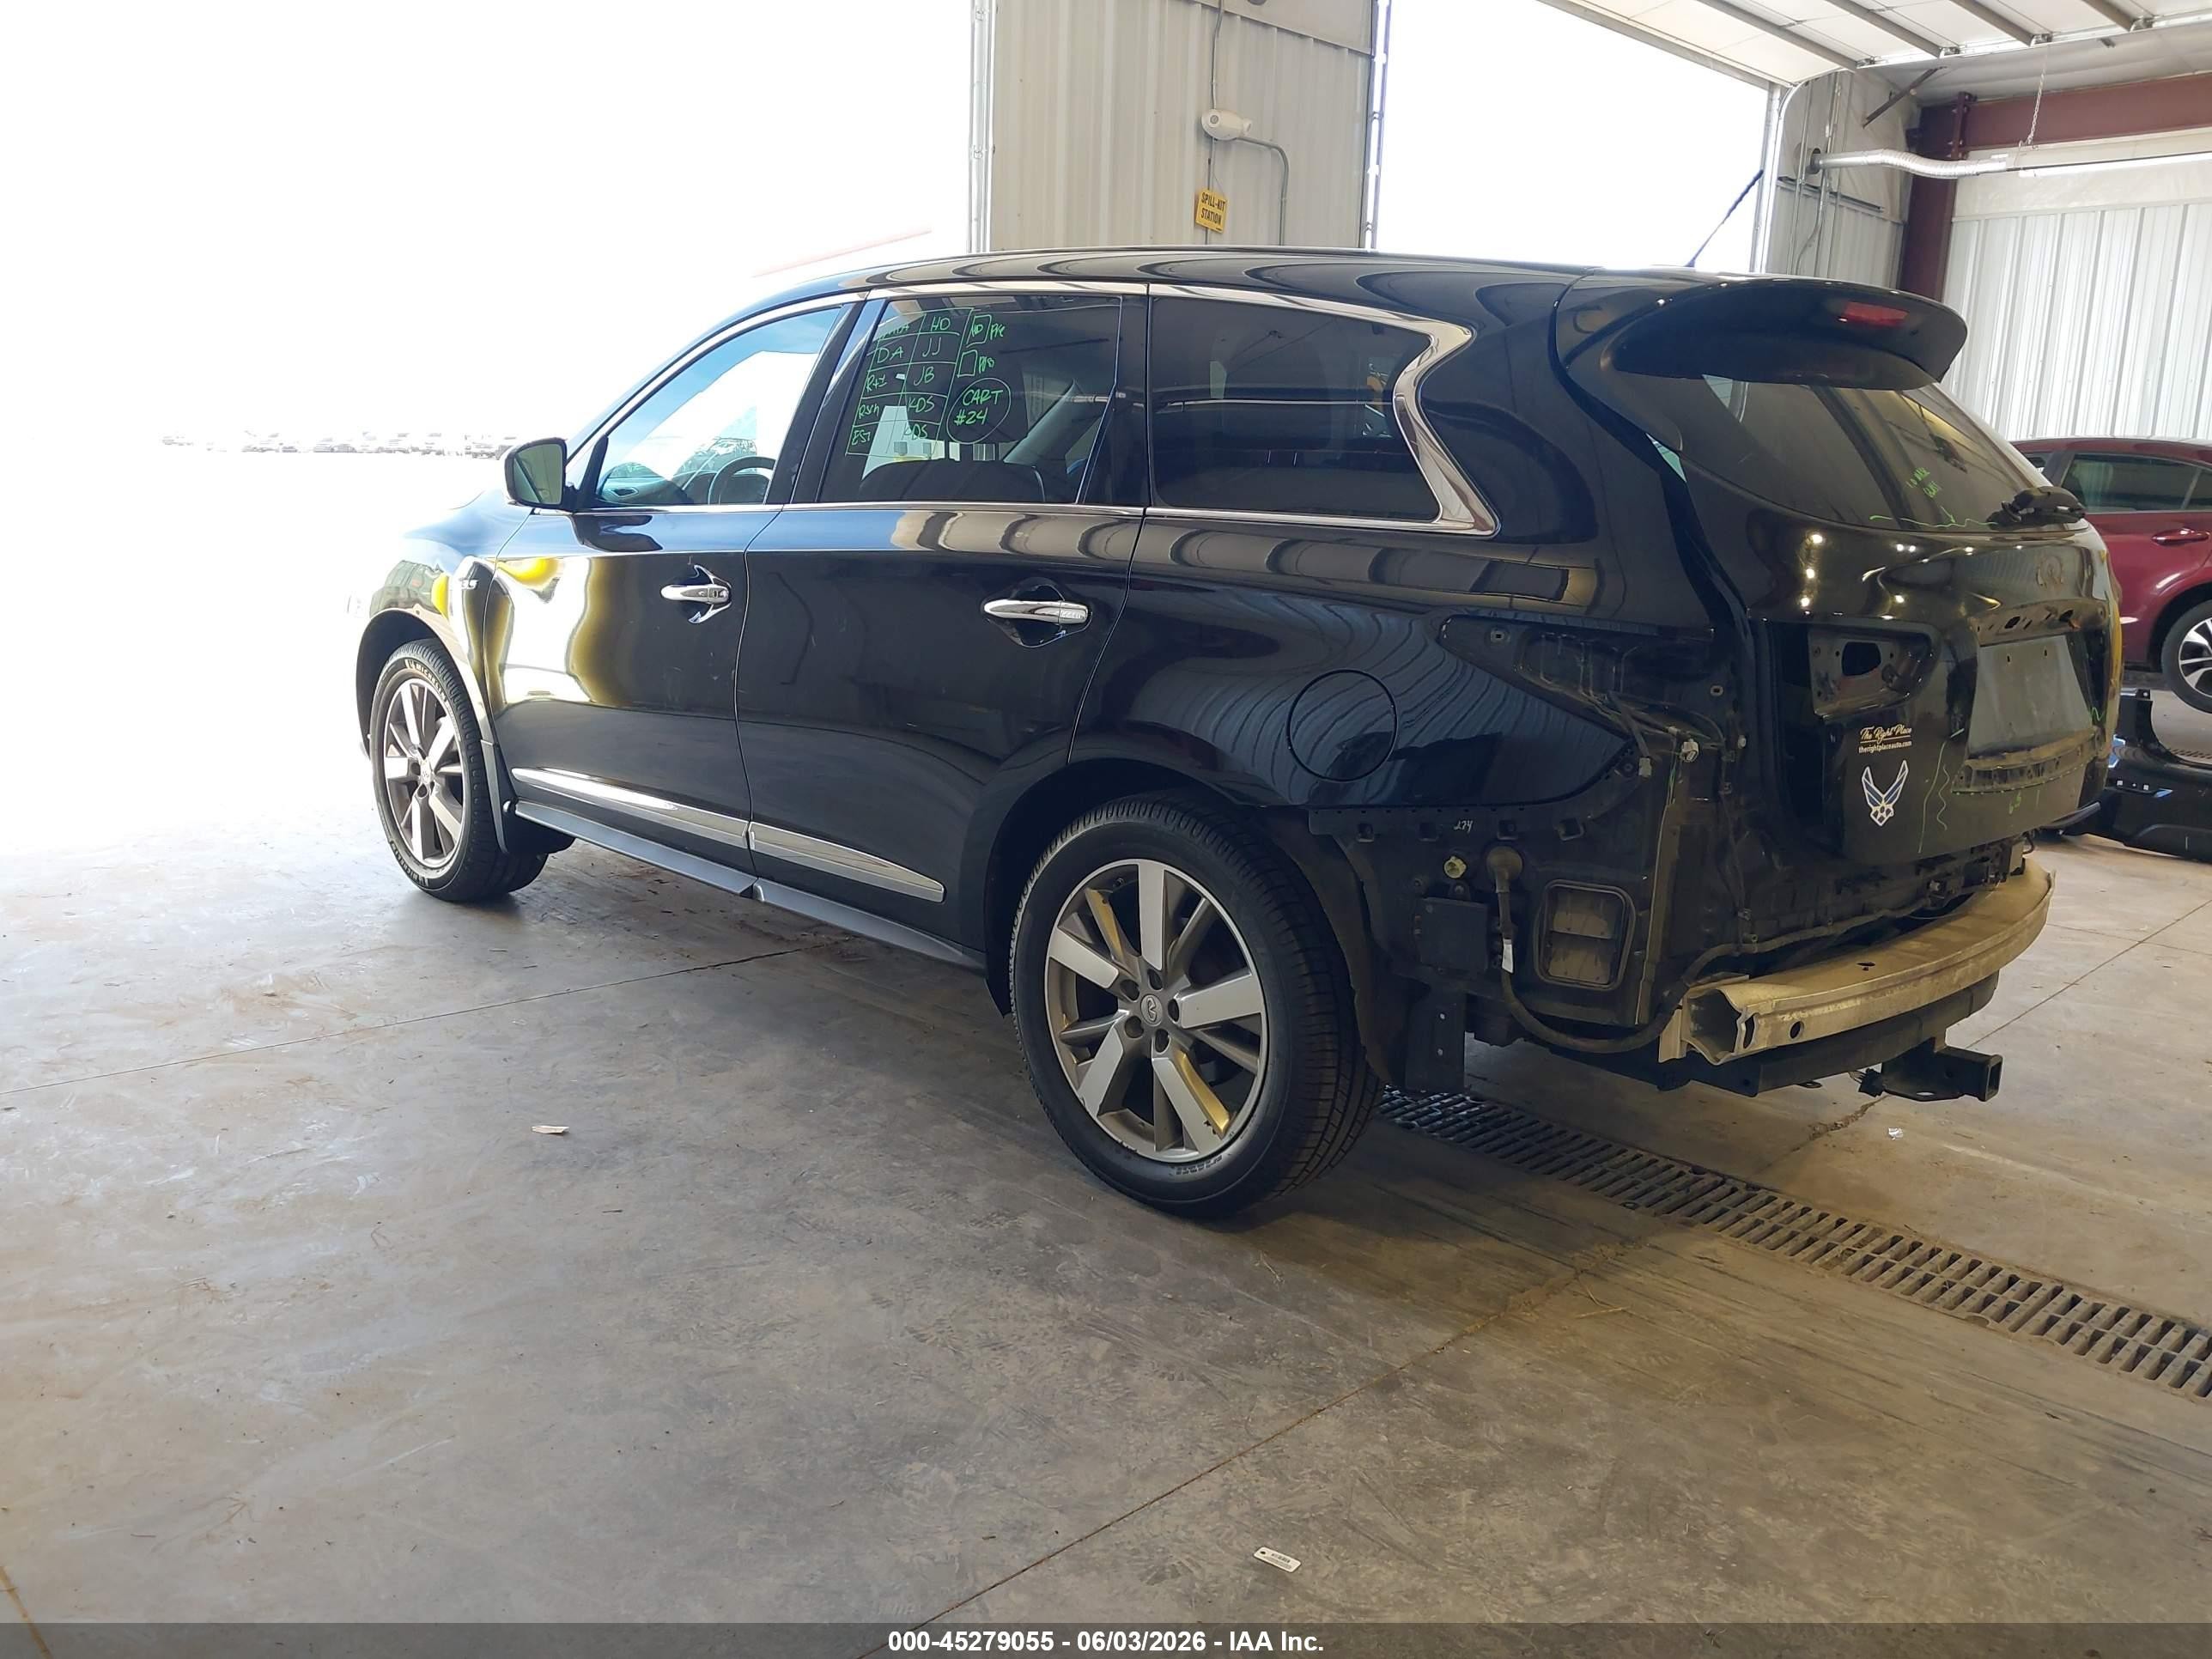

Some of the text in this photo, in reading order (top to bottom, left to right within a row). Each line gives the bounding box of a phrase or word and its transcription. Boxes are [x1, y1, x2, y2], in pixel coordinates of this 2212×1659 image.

[1201, 191, 1225, 211] SPILL-KIT
[1201, 207, 1222, 226] STATION
[877, 346, 903, 364] DA
[922, 337, 941, 357] JJ
[914, 366, 935, 386] JB
[962, 389, 1004, 406] CART
[954, 408, 988, 426] #24
[1860, 724, 1912, 744] The Right Place
[1859, 741, 1912, 754] therightplaceauto.com
